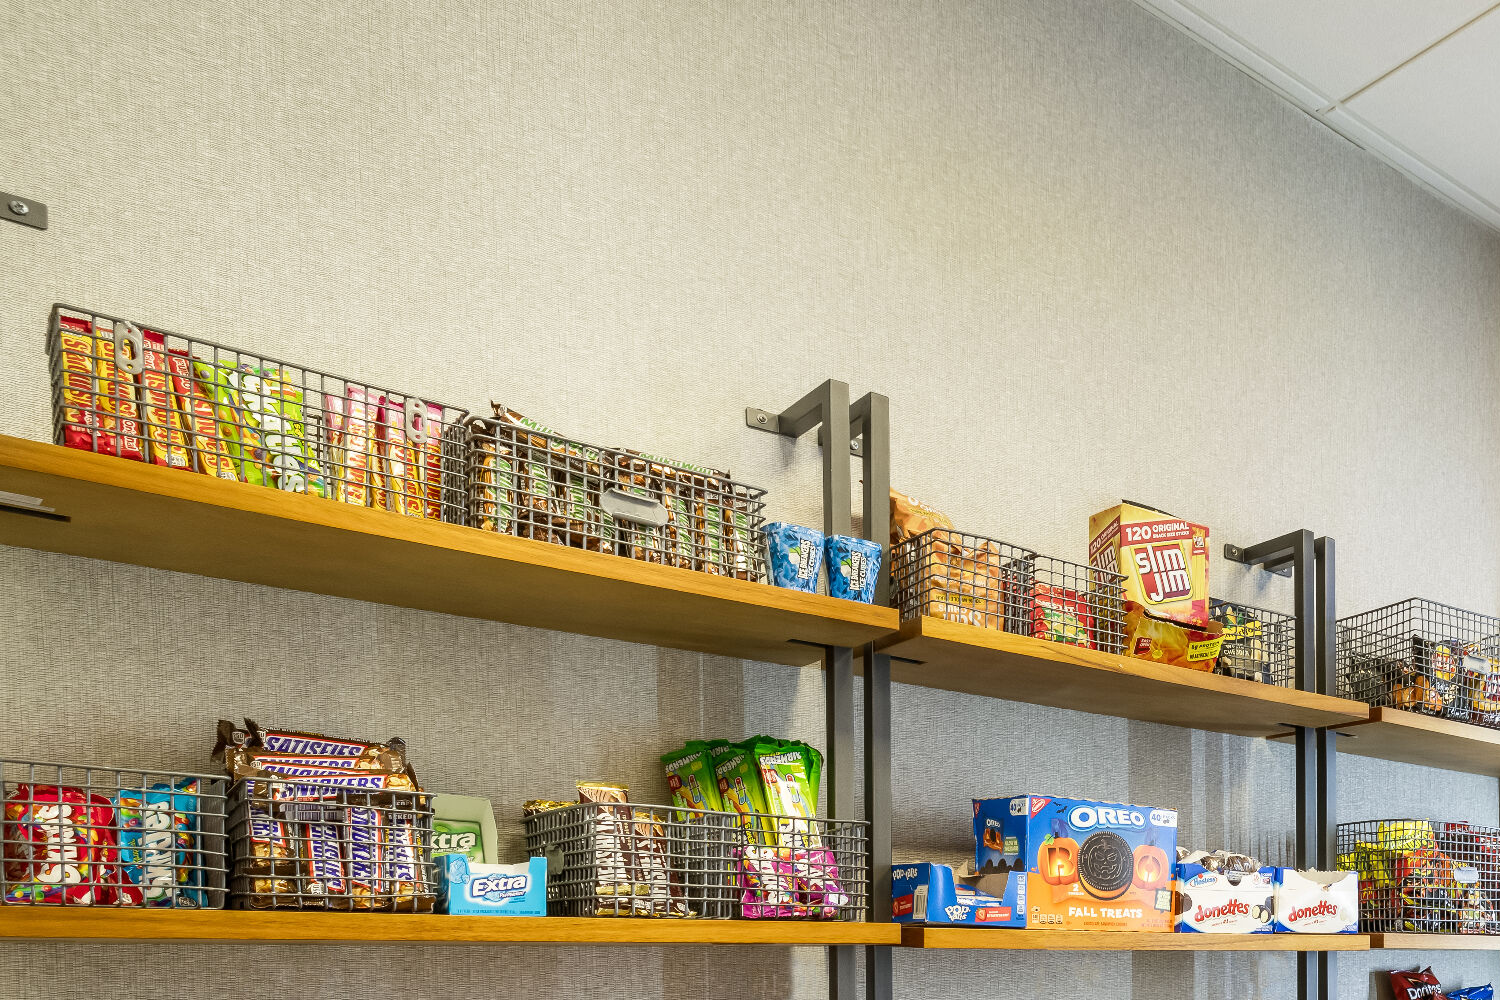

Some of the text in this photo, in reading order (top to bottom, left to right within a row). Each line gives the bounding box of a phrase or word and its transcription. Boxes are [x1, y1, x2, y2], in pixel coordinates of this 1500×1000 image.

[1126, 522, 1189, 541] 120 ORIGINAL
[798, 539, 811, 579] ICE BREAKERS
[1135, 545, 1185, 575] slim
[1151, 569, 1191, 602] jim
[1071, 807, 1145, 827] OREO
[1152, 814, 1161, 822] 40
[472, 876, 527, 897] Extra
[1069, 907, 1143, 919] FALL TREATS
[1194, 899, 1249, 922] donettes
[1288, 901, 1338, 922] donettes
[1407, 984, 1441, 1000] Doritos
